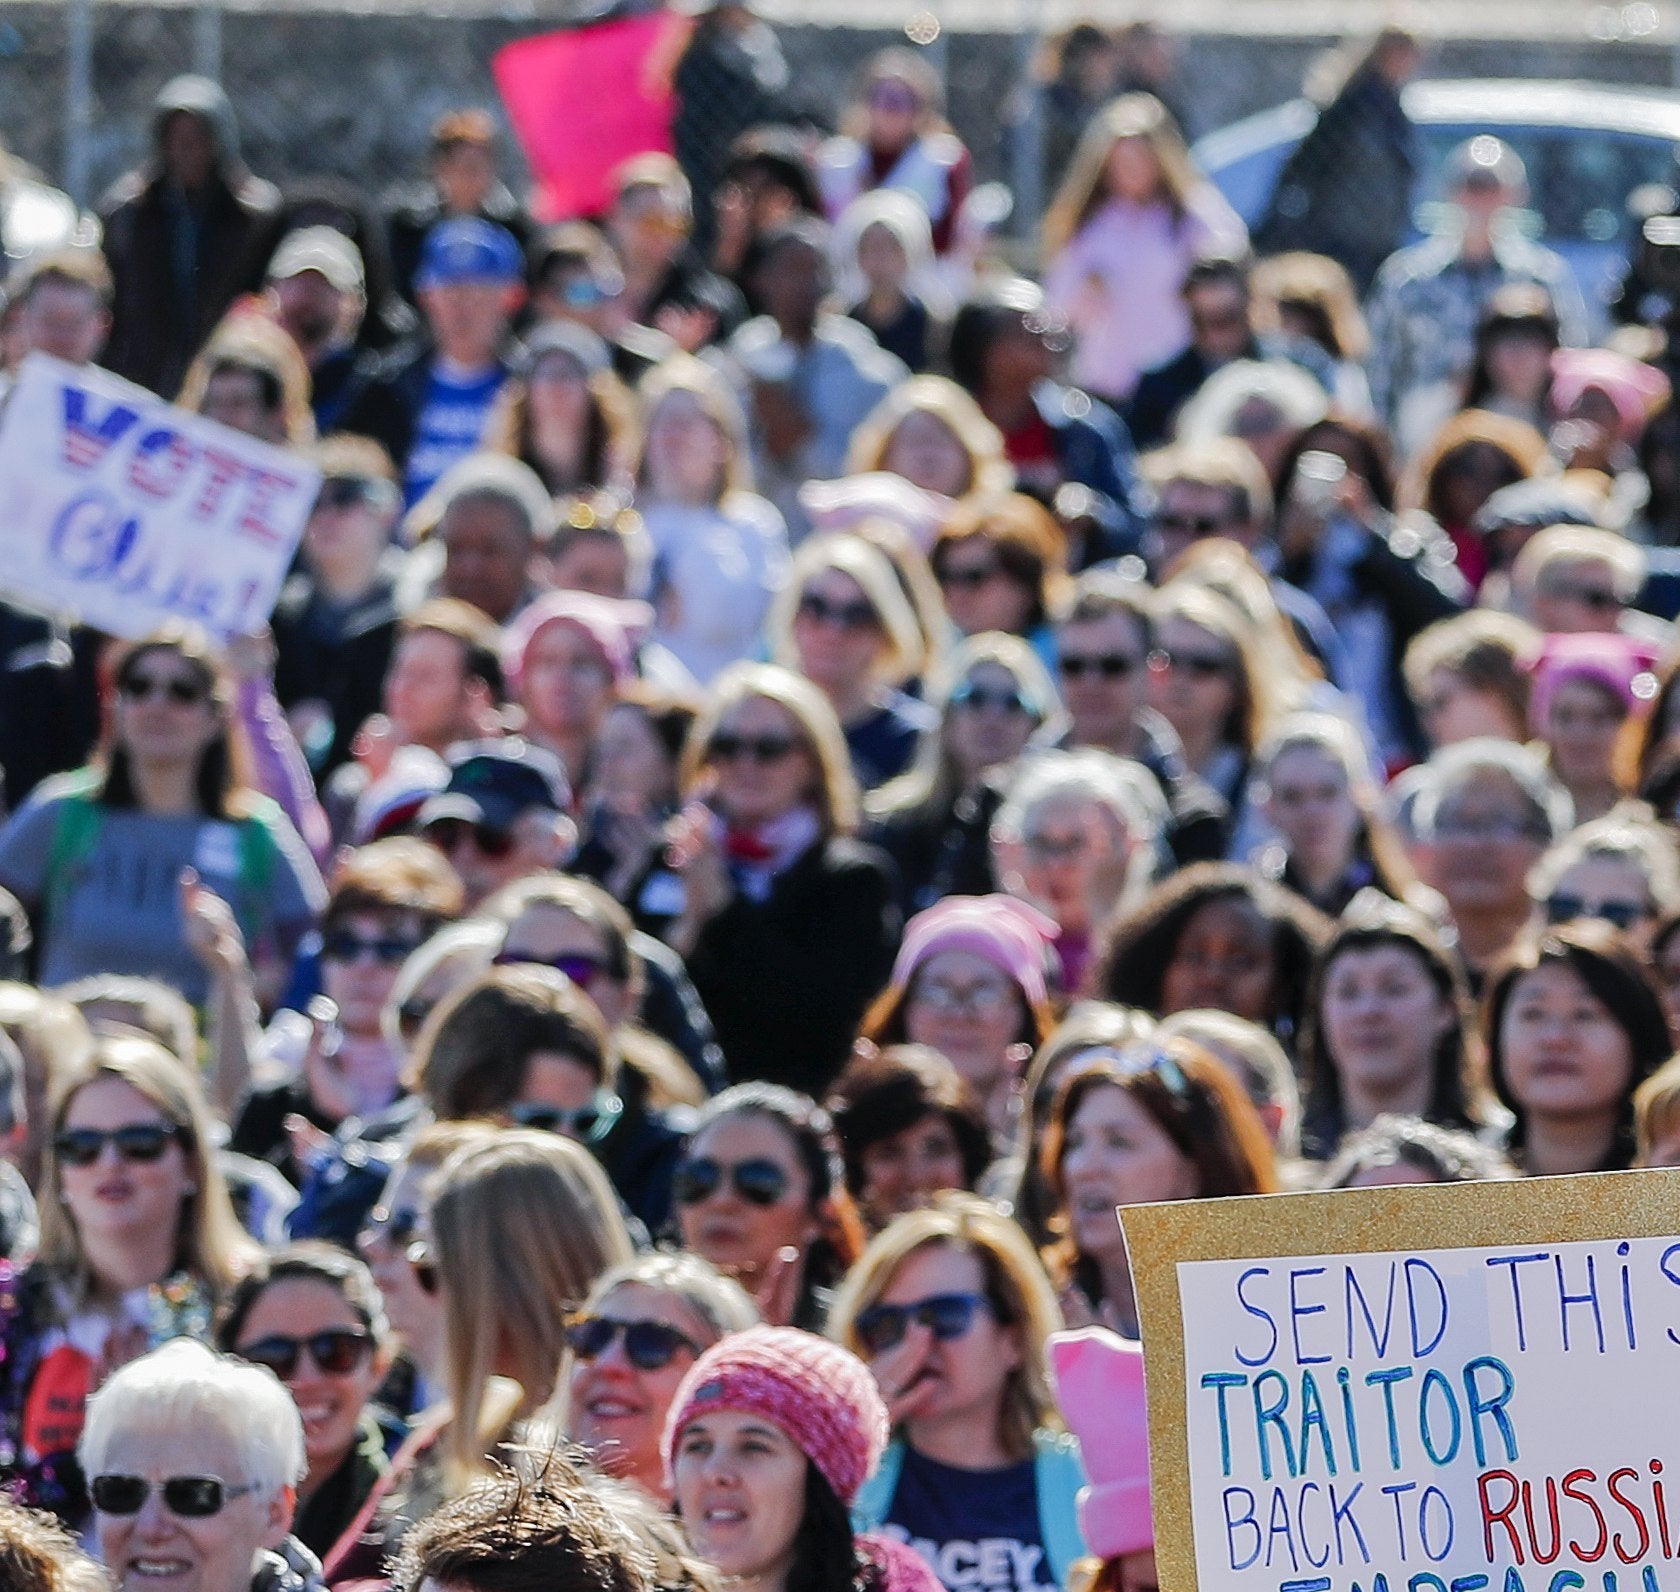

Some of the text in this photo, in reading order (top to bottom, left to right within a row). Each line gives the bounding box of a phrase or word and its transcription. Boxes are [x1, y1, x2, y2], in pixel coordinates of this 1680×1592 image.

[60, 385, 298, 543] VOTE
[1233, 1257, 1450, 1368] SEND
[1222, 1480, 1370, 1574] BACK
[1380, 1480, 1455, 1568] TO
